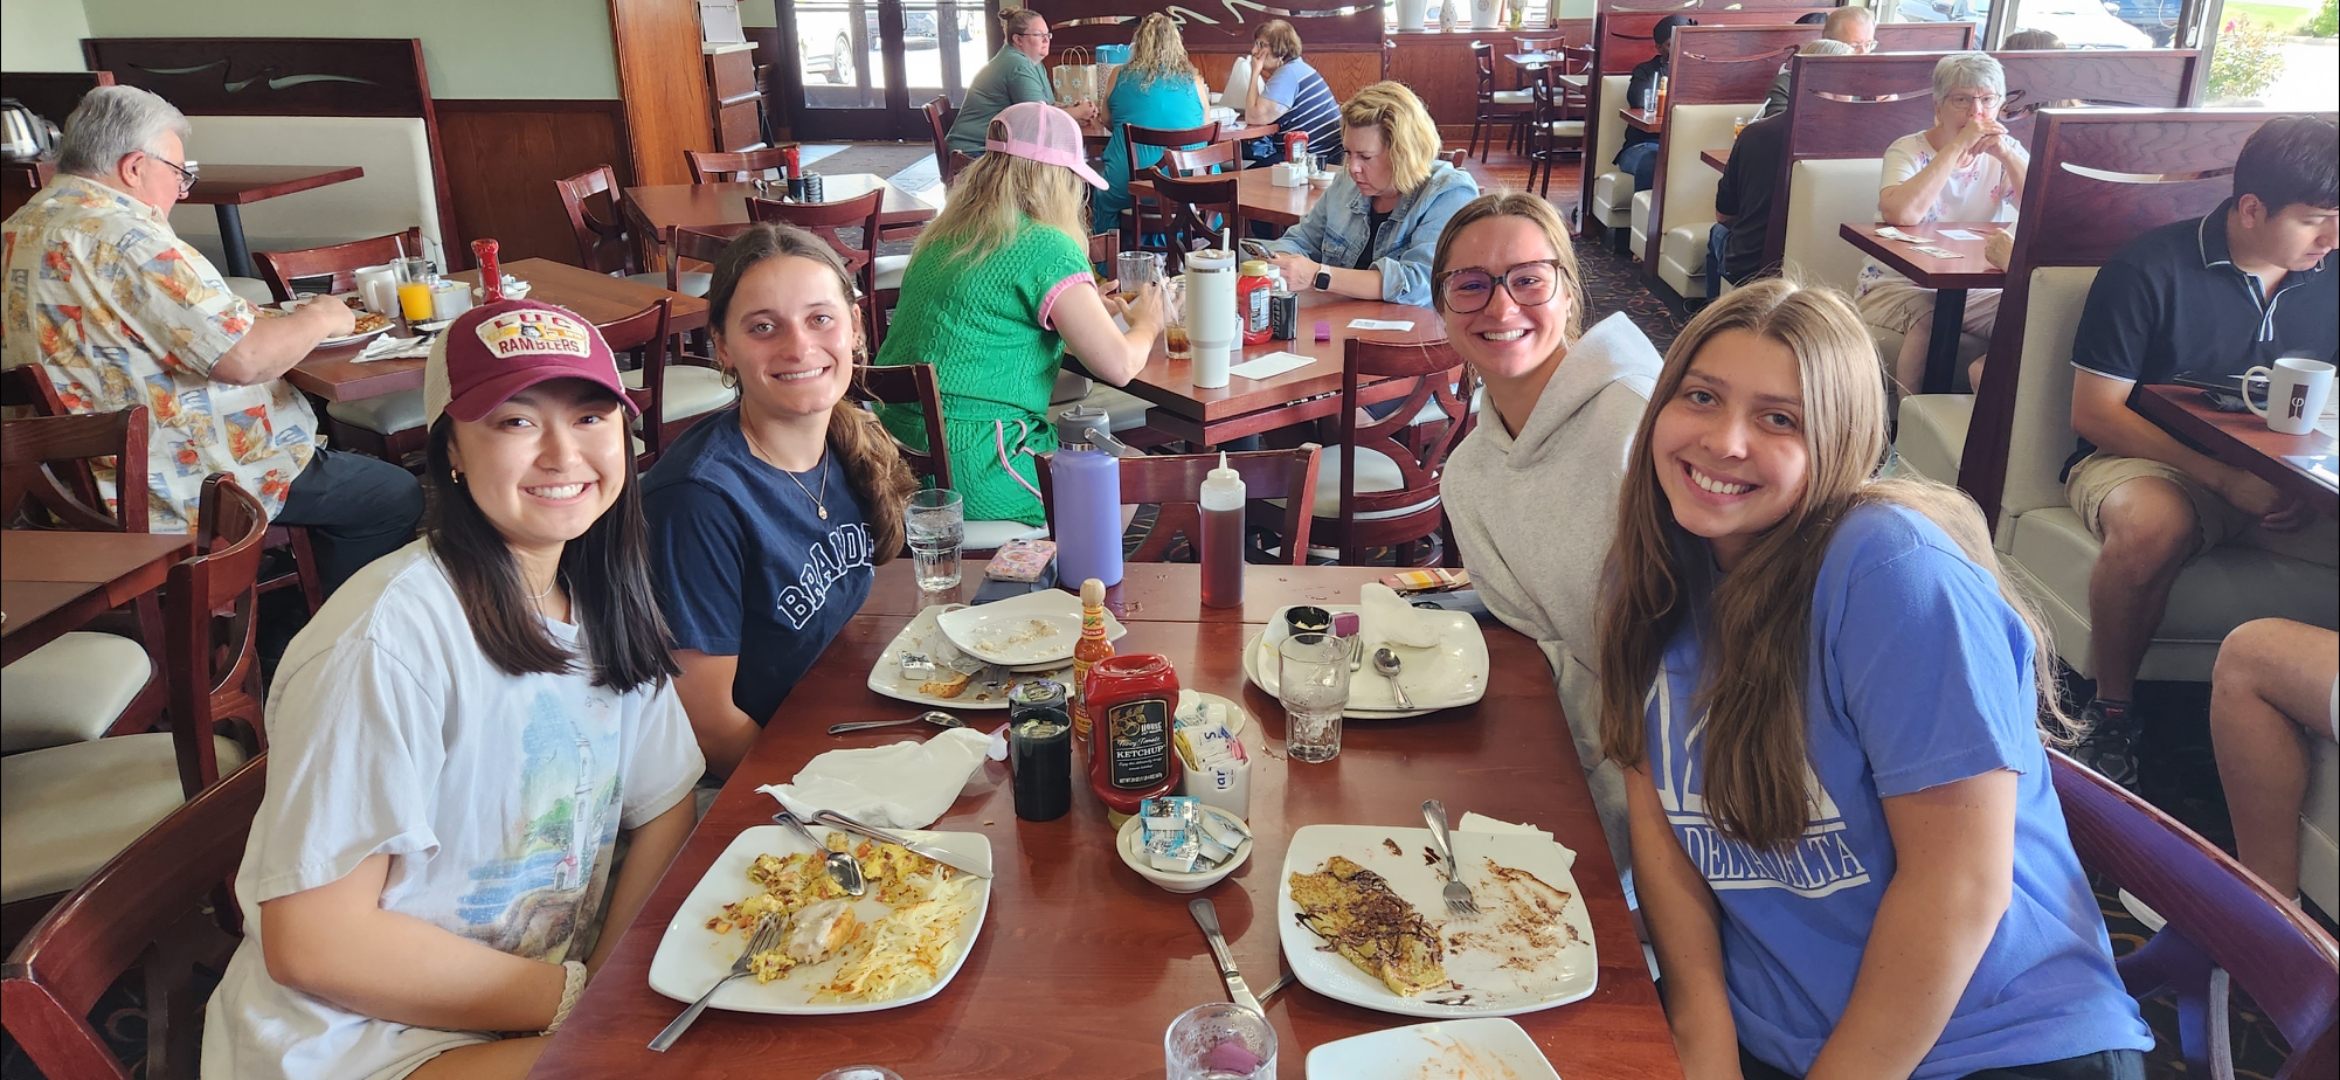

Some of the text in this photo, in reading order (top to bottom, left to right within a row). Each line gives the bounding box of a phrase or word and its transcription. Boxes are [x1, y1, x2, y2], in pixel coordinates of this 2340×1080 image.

[494, 314, 572, 329] LUC
[499, 338, 580, 354] RAMBLERS
[1117, 746, 1163, 758] KETCHUP
